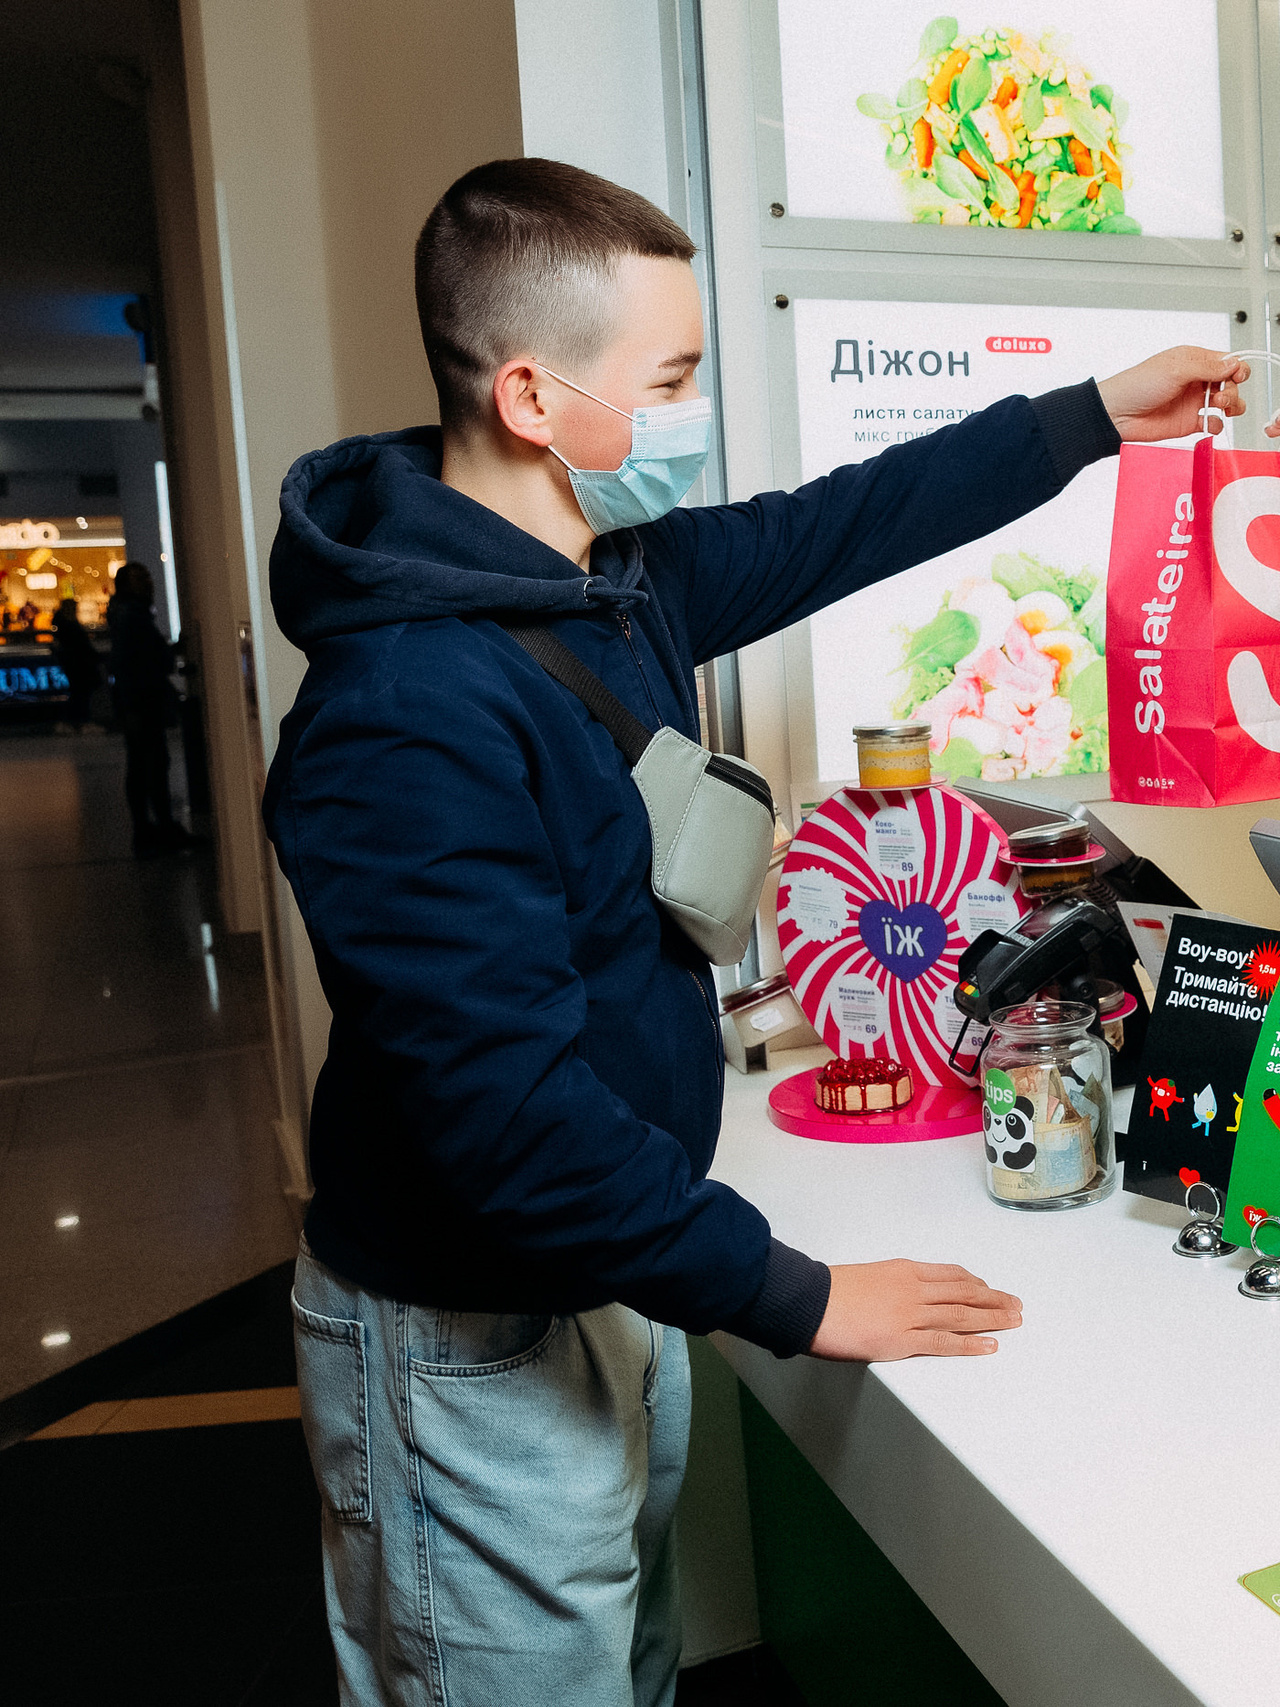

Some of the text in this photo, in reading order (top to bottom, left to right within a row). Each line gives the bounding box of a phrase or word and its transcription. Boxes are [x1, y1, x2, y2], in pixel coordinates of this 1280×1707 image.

[992, 337, 1047, 352] deluxe
[830, 338, 971, 384] Діжон
[853, 408, 906, 420] листя
[854, 428, 890, 442] мікс
[1134, 492, 1195, 735] Salateira
[901, 862, 914, 872] 89
[881, 916, 925, 958] їж
[1178, 937, 1255, 970] Воу-воу!
[1173, 965, 1259, 999] Тримайте
[1165, 990, 1269, 1023] дистанцію!
[865, 1024, 877, 1034] 69
[971, 1036, 984, 1047] 69
[985, 1078, 1014, 1105] tips
